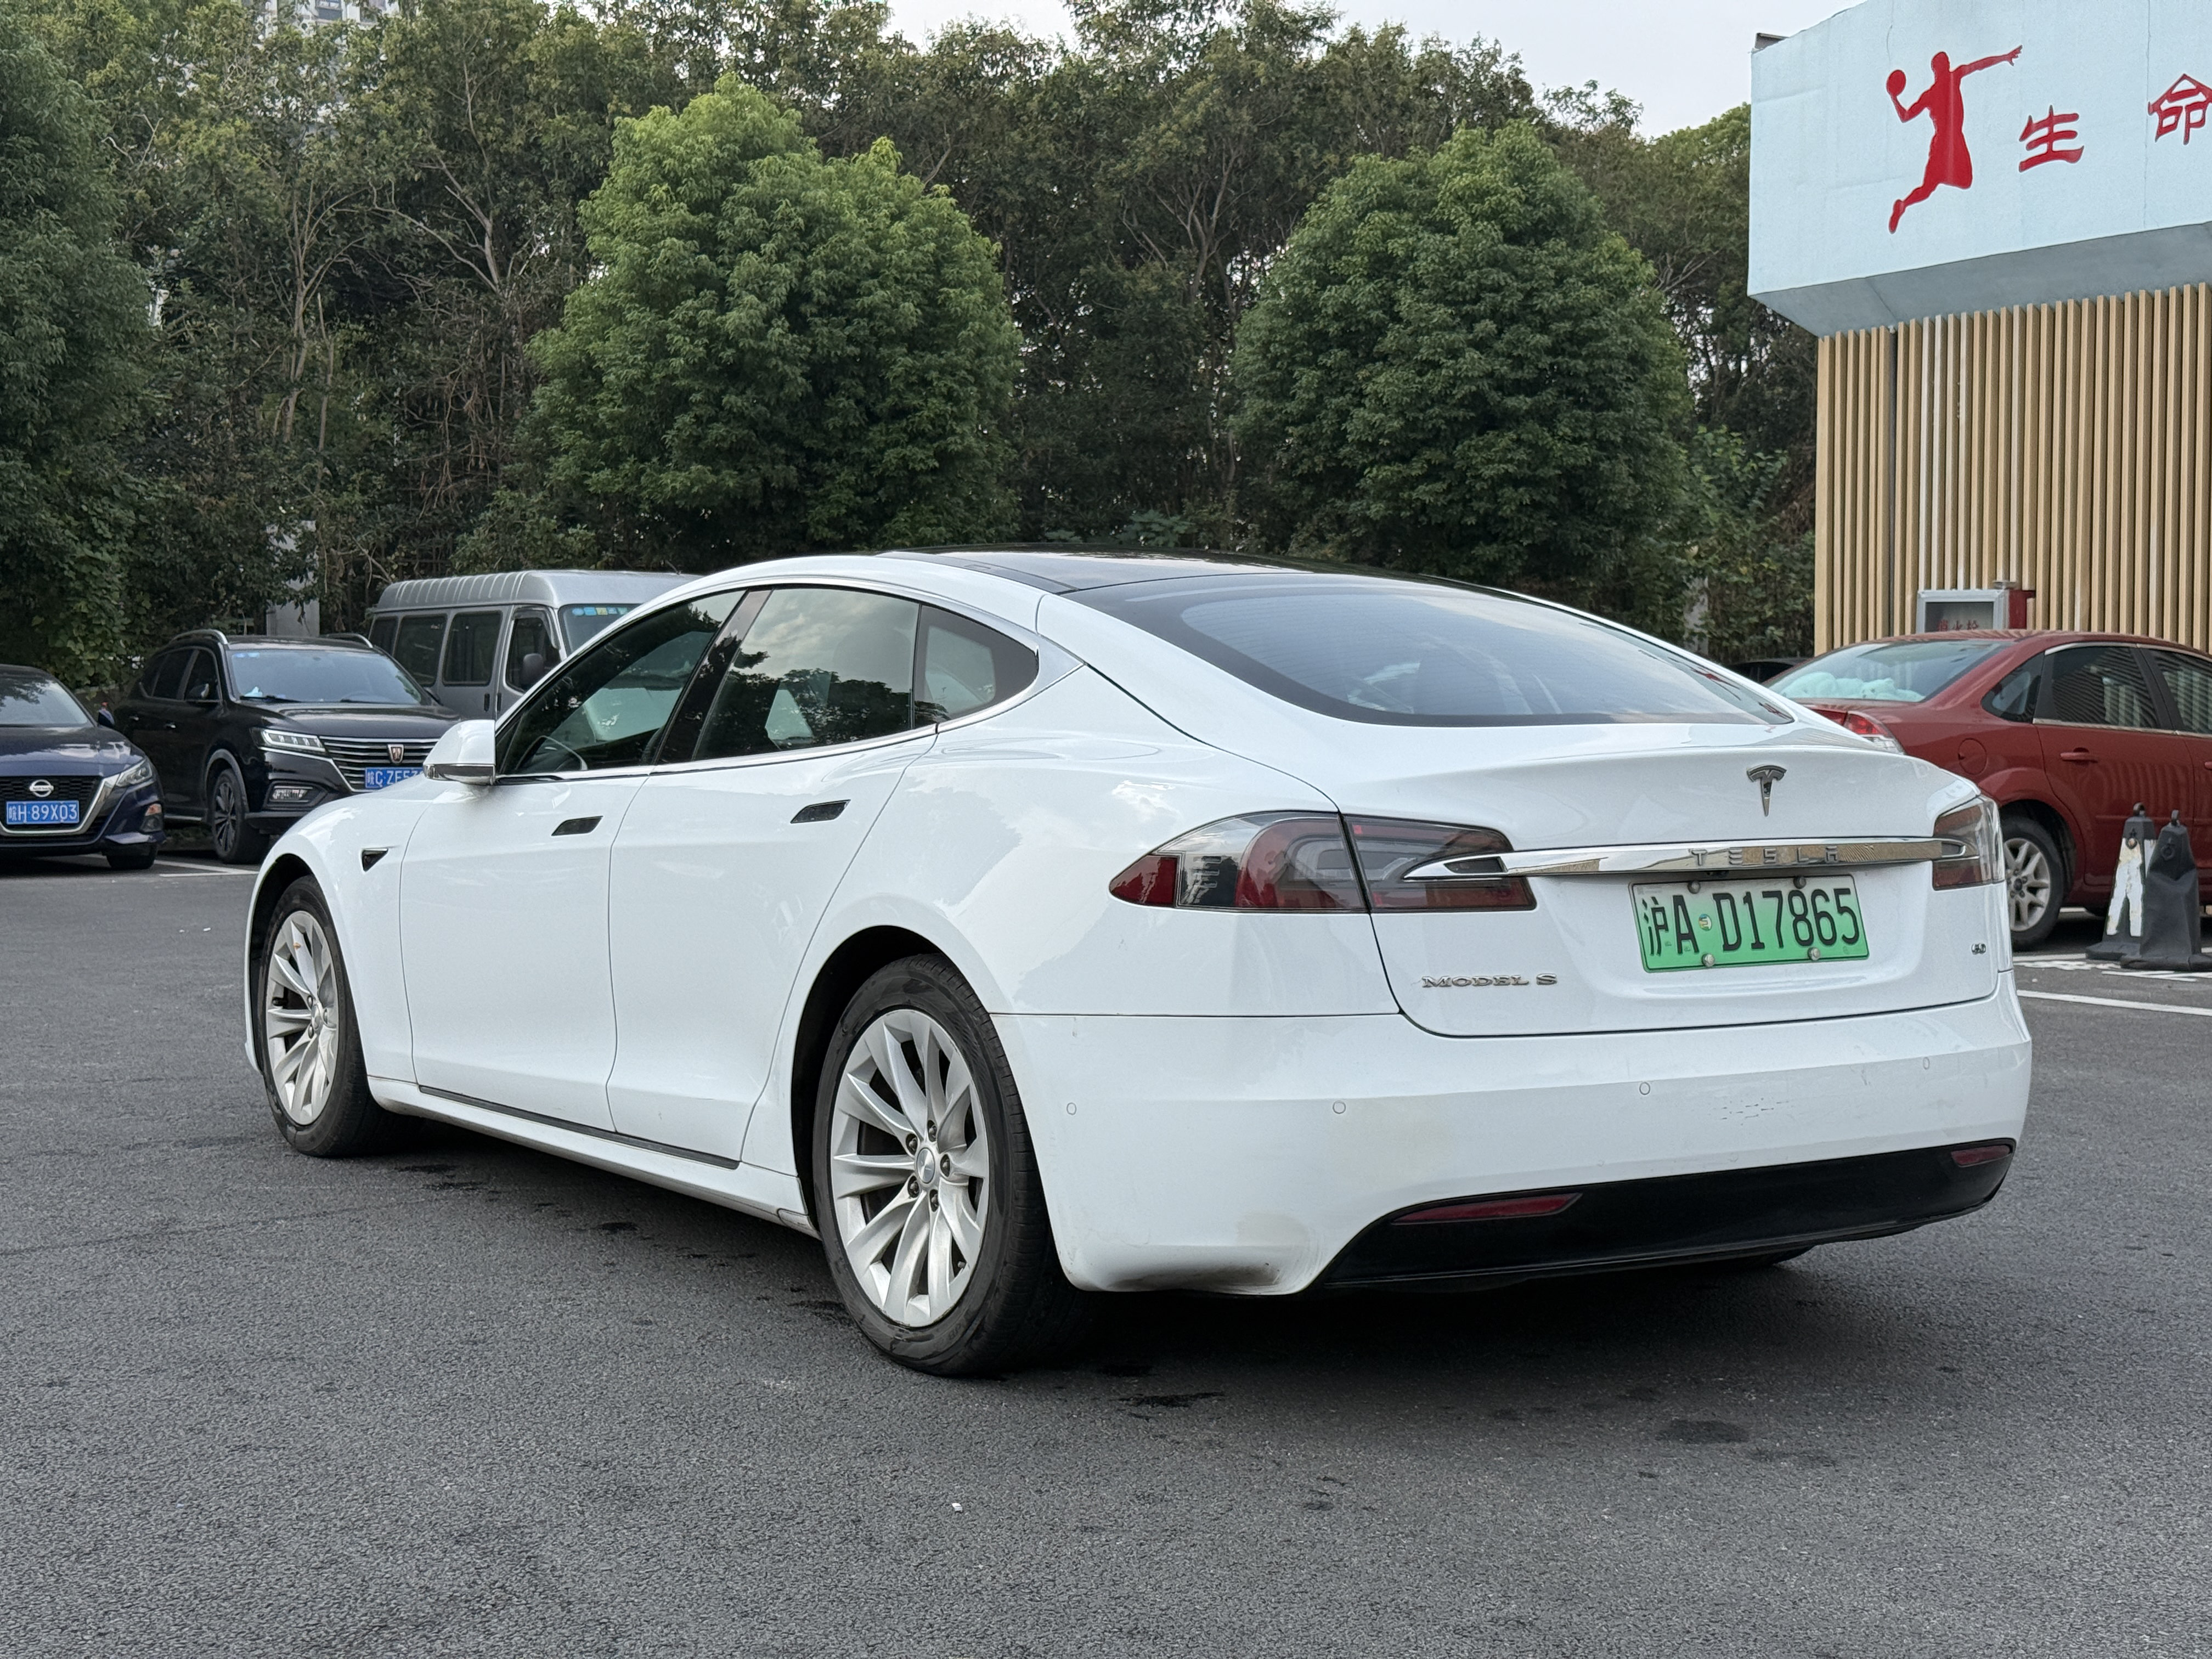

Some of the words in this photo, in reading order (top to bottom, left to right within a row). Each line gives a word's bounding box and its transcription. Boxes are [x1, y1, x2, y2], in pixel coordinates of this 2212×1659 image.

[2018, 74, 2212, 172] 生命
[1691, 845, 1838, 866] TESLA
[1422, 975, 1530, 988] MODEL
[1536, 973, 1558, 986] S
